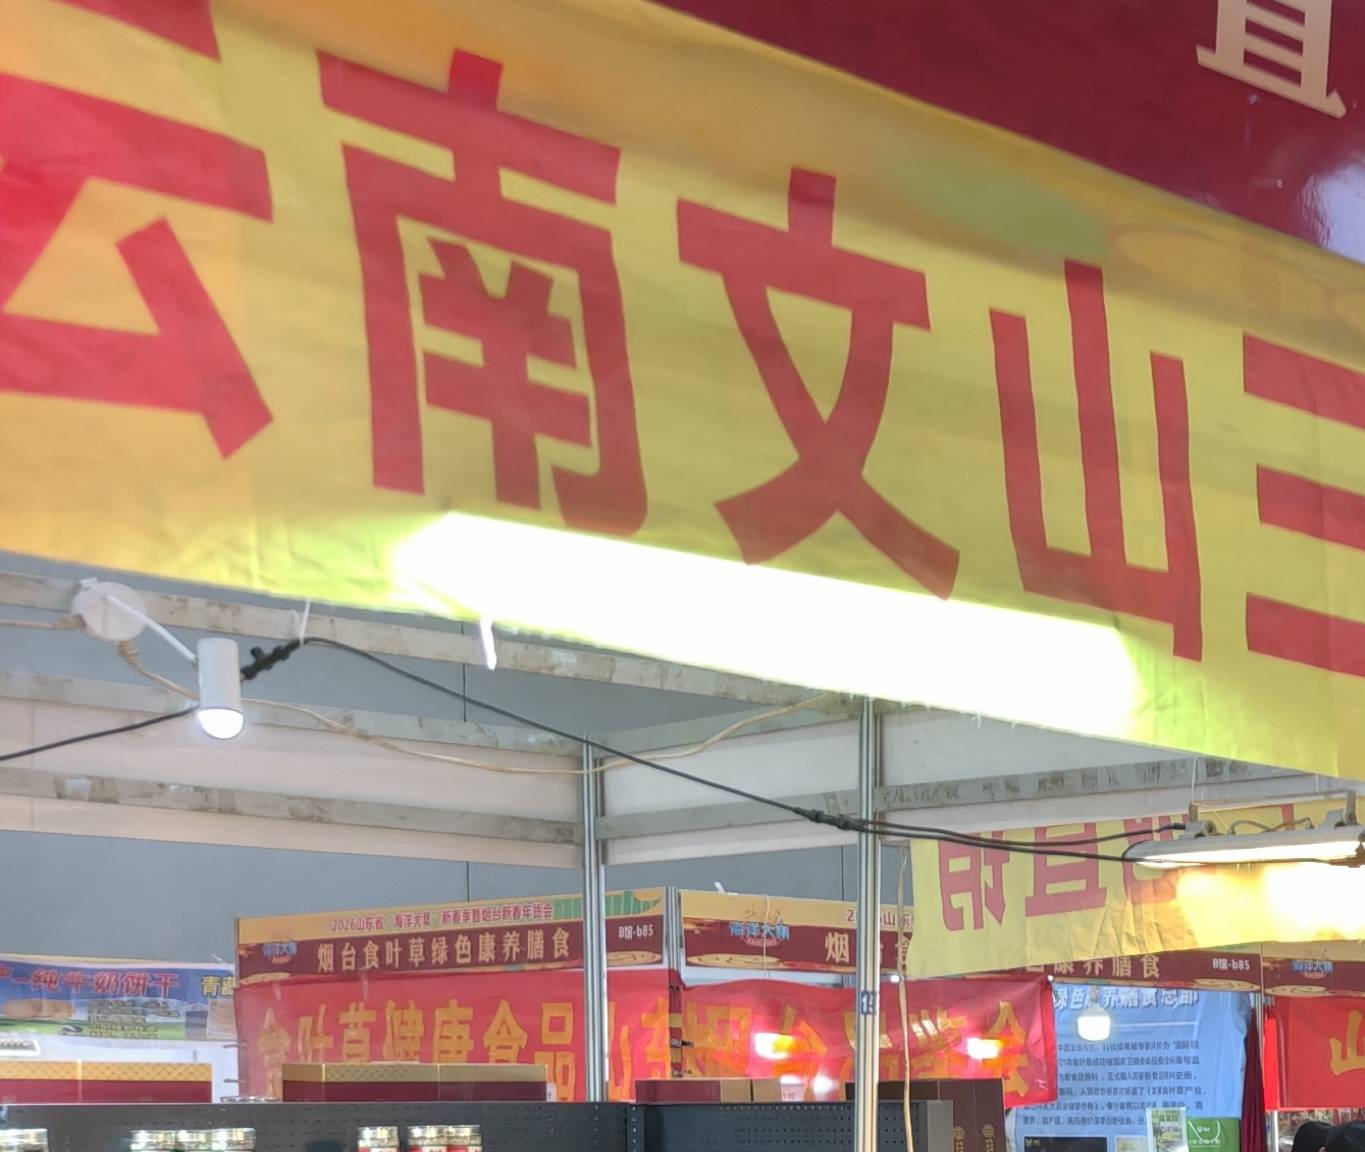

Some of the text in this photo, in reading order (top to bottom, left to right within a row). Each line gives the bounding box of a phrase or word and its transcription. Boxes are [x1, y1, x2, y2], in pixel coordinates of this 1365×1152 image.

[317, 927, 571, 973] 烟台食叶草绿色康养膳食
